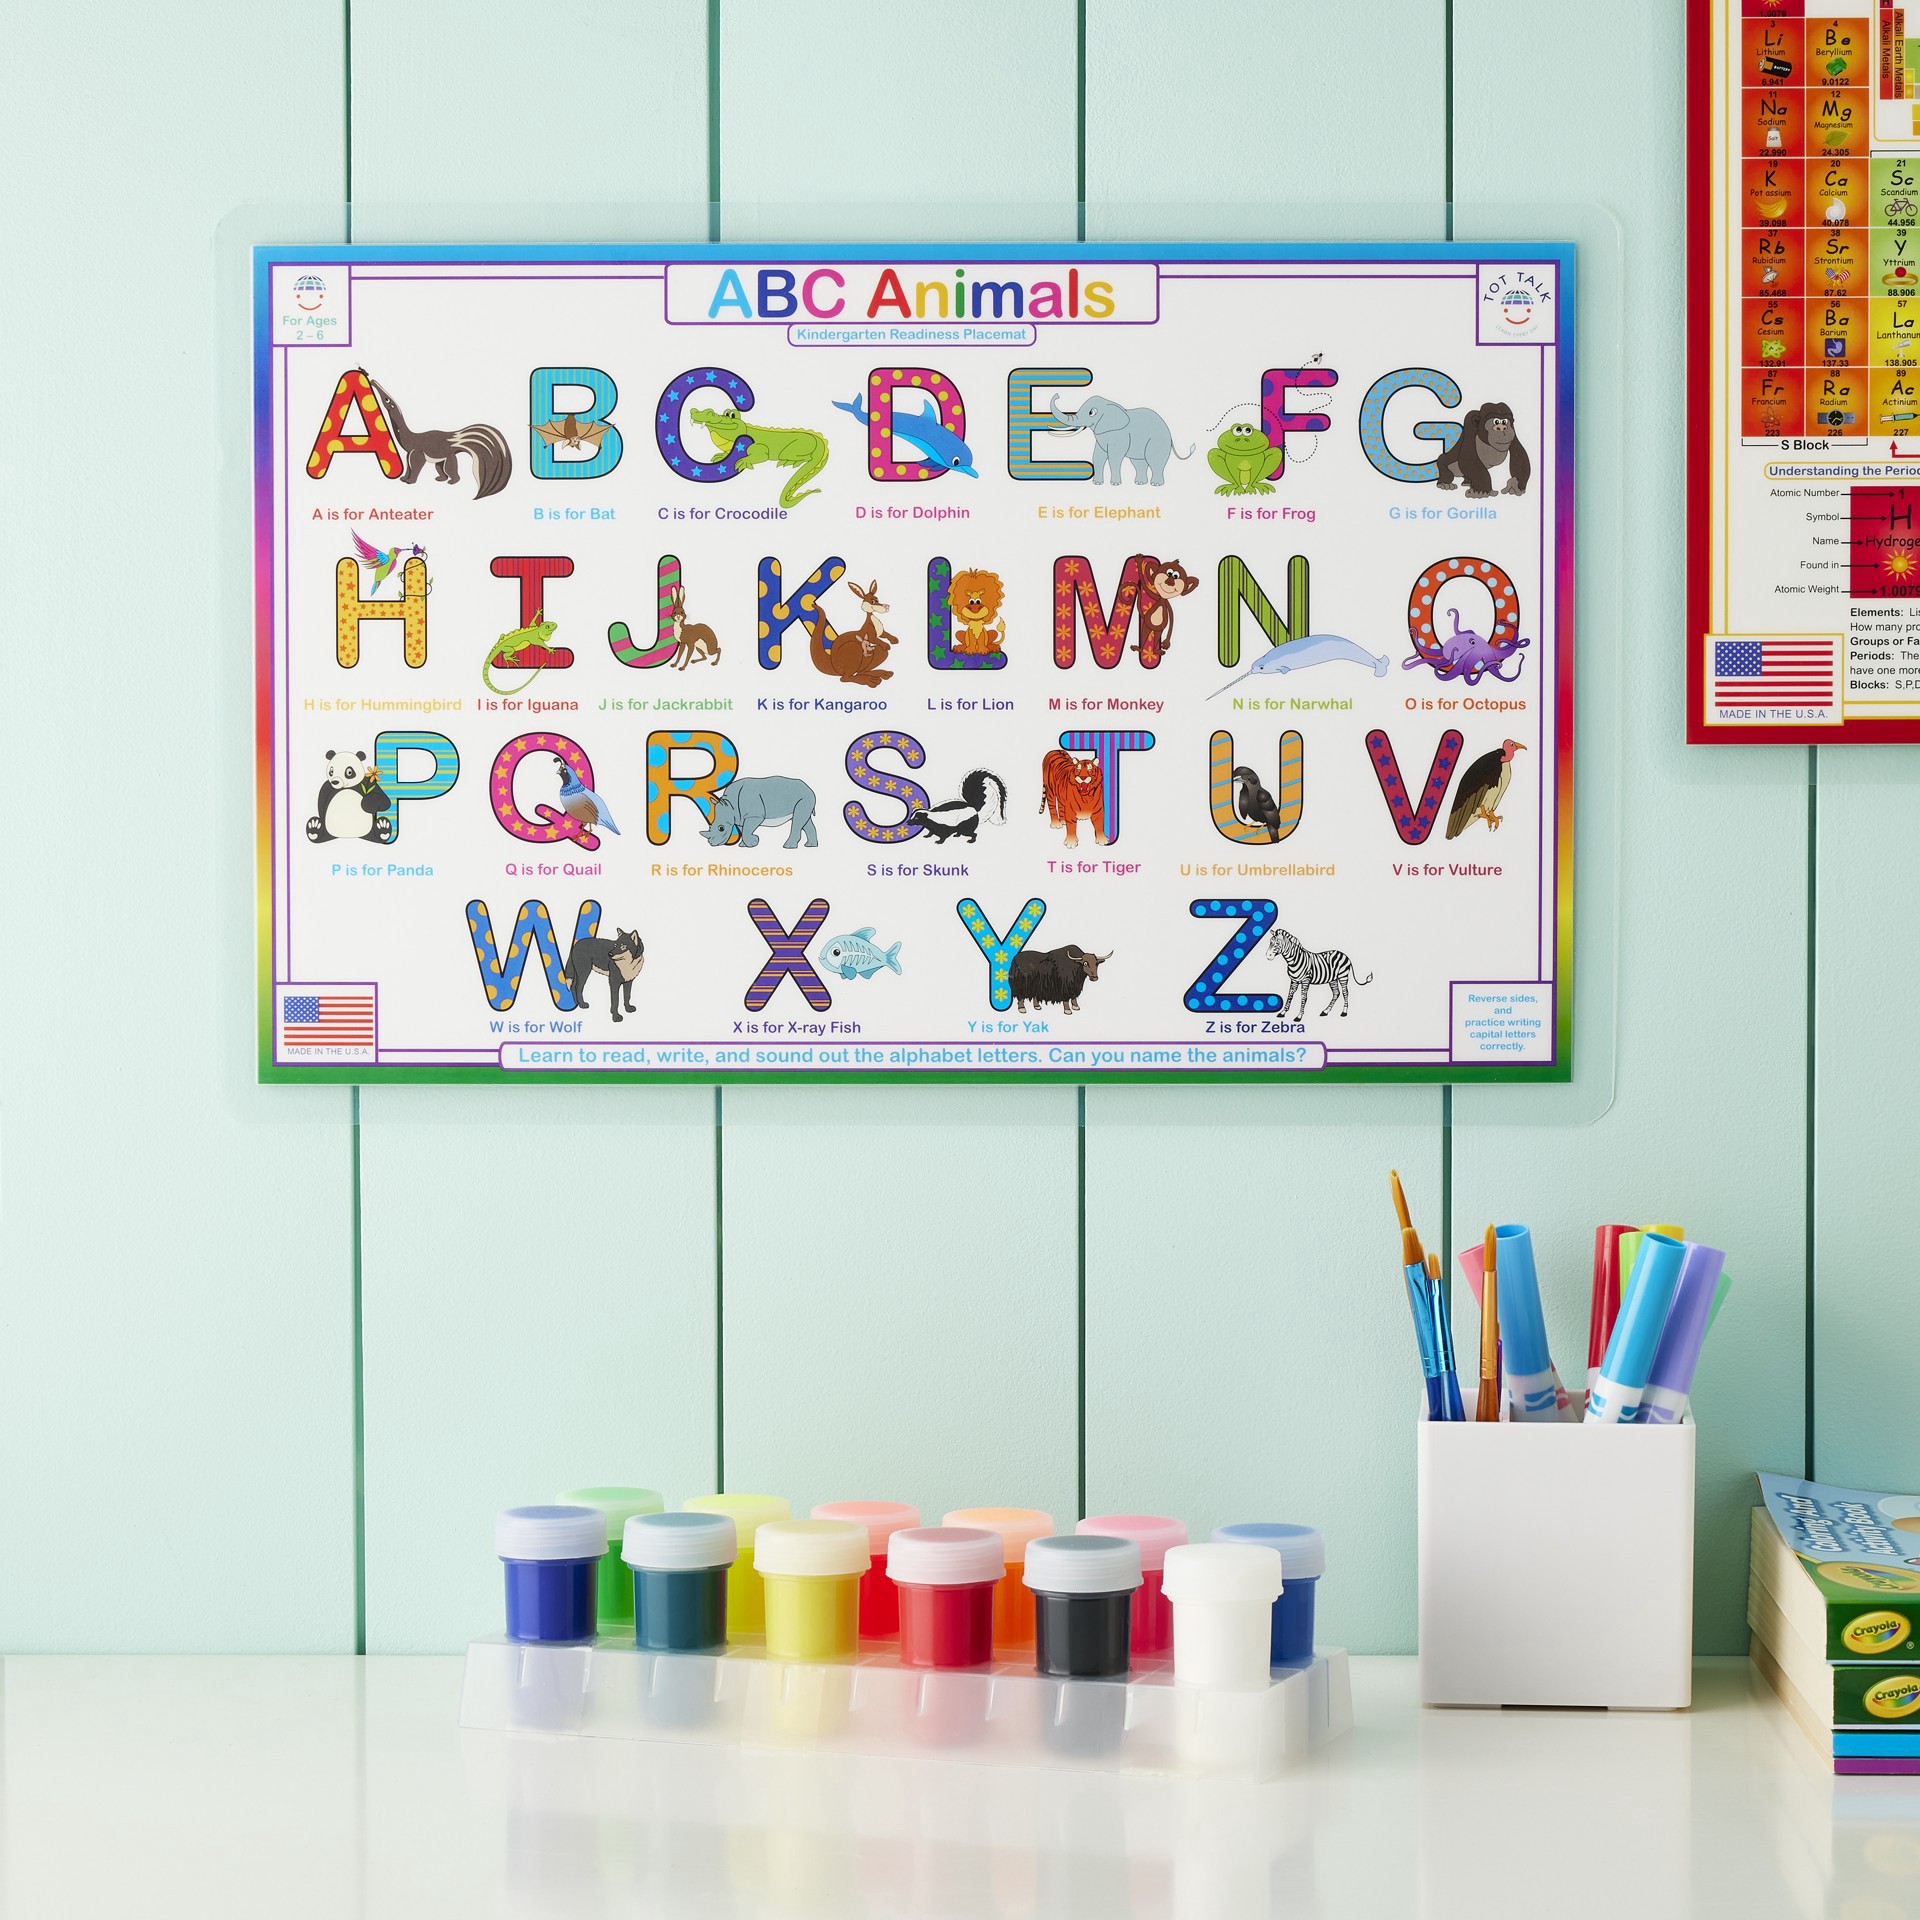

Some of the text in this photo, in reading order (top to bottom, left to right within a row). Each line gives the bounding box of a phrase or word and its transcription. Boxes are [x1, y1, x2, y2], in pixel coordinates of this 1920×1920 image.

[1765, 30, 1783, 46] Li
[1826, 29, 1851, 45] Be
[1757, 48, 1785, 57] Lithium
[1816, 48, 1852, 57] Beryllium
[1882, 20, 1890, 79] Alkali Metals
[1895, 11, 1903, 98] Alkali Earth Metals
[1761, 78, 1785, 86] 6.941
[1761, 99, 1787, 115] Na
[1822, 100, 1852, 121] Mg
[1814, 119, 1852, 130] Magnesium
[1881, 188, 1918, 196] Scandium
[1760, 238, 1785, 254] Rb
[1883, 259, 1915, 268] Yttrium
[708, 268, 1115, 319] ABC Animals
[1483, 271, 1552, 304] TOT TALK
[283, 316, 337, 328] For Ages
[297, 331, 303, 340] 2
[317, 330, 323, 340] 6
[798, 329, 1026, 342] Kindergarten Readiness Placemat
[1820, 328, 1847, 336] Barium
[306, 370, 404, 480] A
[529, 367, 624, 480] B
[1007, 367, 1095, 481] E
[1781, 440, 1829, 450] S Block
[1769, 466, 1859, 477] Understanding
[1862, 466, 1882, 475] the
[1770, 489, 1840, 497] Atomic Number
[312, 508, 434, 520] A is for Anteater
[658, 507, 788, 520] C is for Crocodile
[1038, 506, 1160, 521] E is for Elephant
[1806, 512, 1839, 523] Symbol
[1813, 537, 1839, 545] Name
[1800, 561, 1839, 569] Found in
[1774, 585, 1839, 595] Atomic Weight
[336, 556, 427, 669] H
[490, 556, 575, 669] I
[1851, 608, 1903, 617] Elements:
[1850, 637, 1890, 648] Groups
[1850, 651, 1919, 660] Periods: The
[1850, 666, 1874, 675] have
[1850, 680, 1889, 689] Blocks:
[304, 699, 461, 713] H is for Hummingbird
[758, 698, 887, 713] K is for Kangaroo
[1233, 698, 1352, 710] N is for Narwhal
[1720, 709, 1828, 718] MADE IN THE U.S.A.
[1365, 729, 1464, 845] V
[652, 864, 793, 876] R is for Rhinoceros
[1047, 861, 1141, 876] T is for Tiger
[1181, 864, 1335, 876] U is for Umbrellabird
[744, 898, 833, 1012] X
[1183, 898, 1283, 1013] Z
[1469, 994, 1537, 1003] Reverse sides,
[733, 1021, 861, 1036] X is for X-ray Fish
[1205, 1021, 1305, 1033] Z is for Zebra
[1465, 1018, 1541, 1028] practice writing
[1470, 1030, 1536, 1040] capital letters
[1480, 1042, 1525, 1052] correctly.
[520, 1047, 1306, 1066] Learn to read, write, and sound out the alphabet letters. Can you name the animals?
[1833, 1502, 1899, 1556] Activity Book
[1853, 1620, 1898, 1636] Crayola
[1874, 1684, 1919, 1700] Crayola
